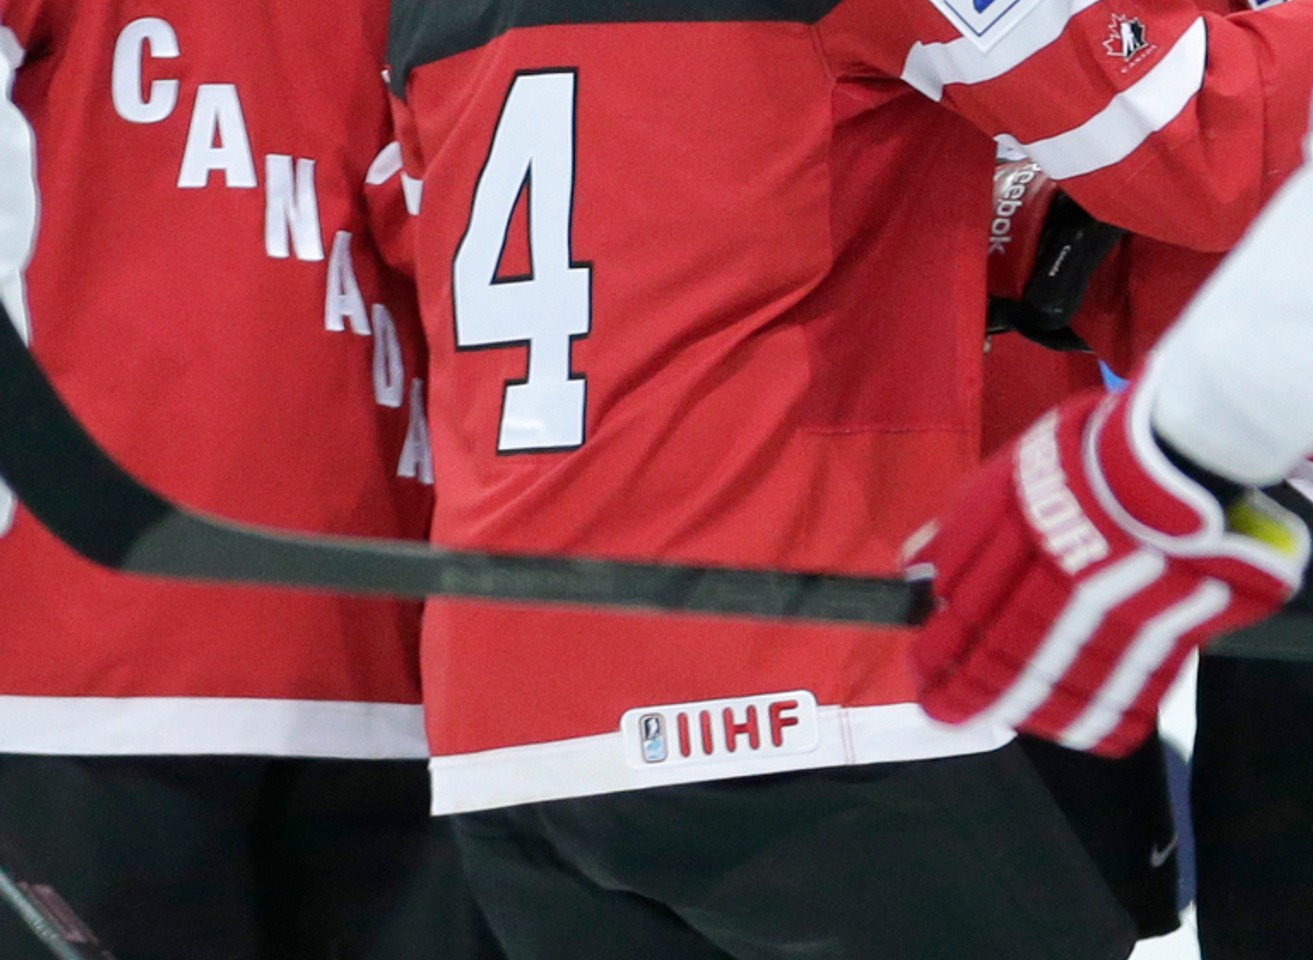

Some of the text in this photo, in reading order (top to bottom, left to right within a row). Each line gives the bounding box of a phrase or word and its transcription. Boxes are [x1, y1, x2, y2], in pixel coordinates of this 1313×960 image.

[111, 17, 434, 486] CANADA
[452, 66, 592, 455] 4
[676, 699, 800, 759] IIHF
